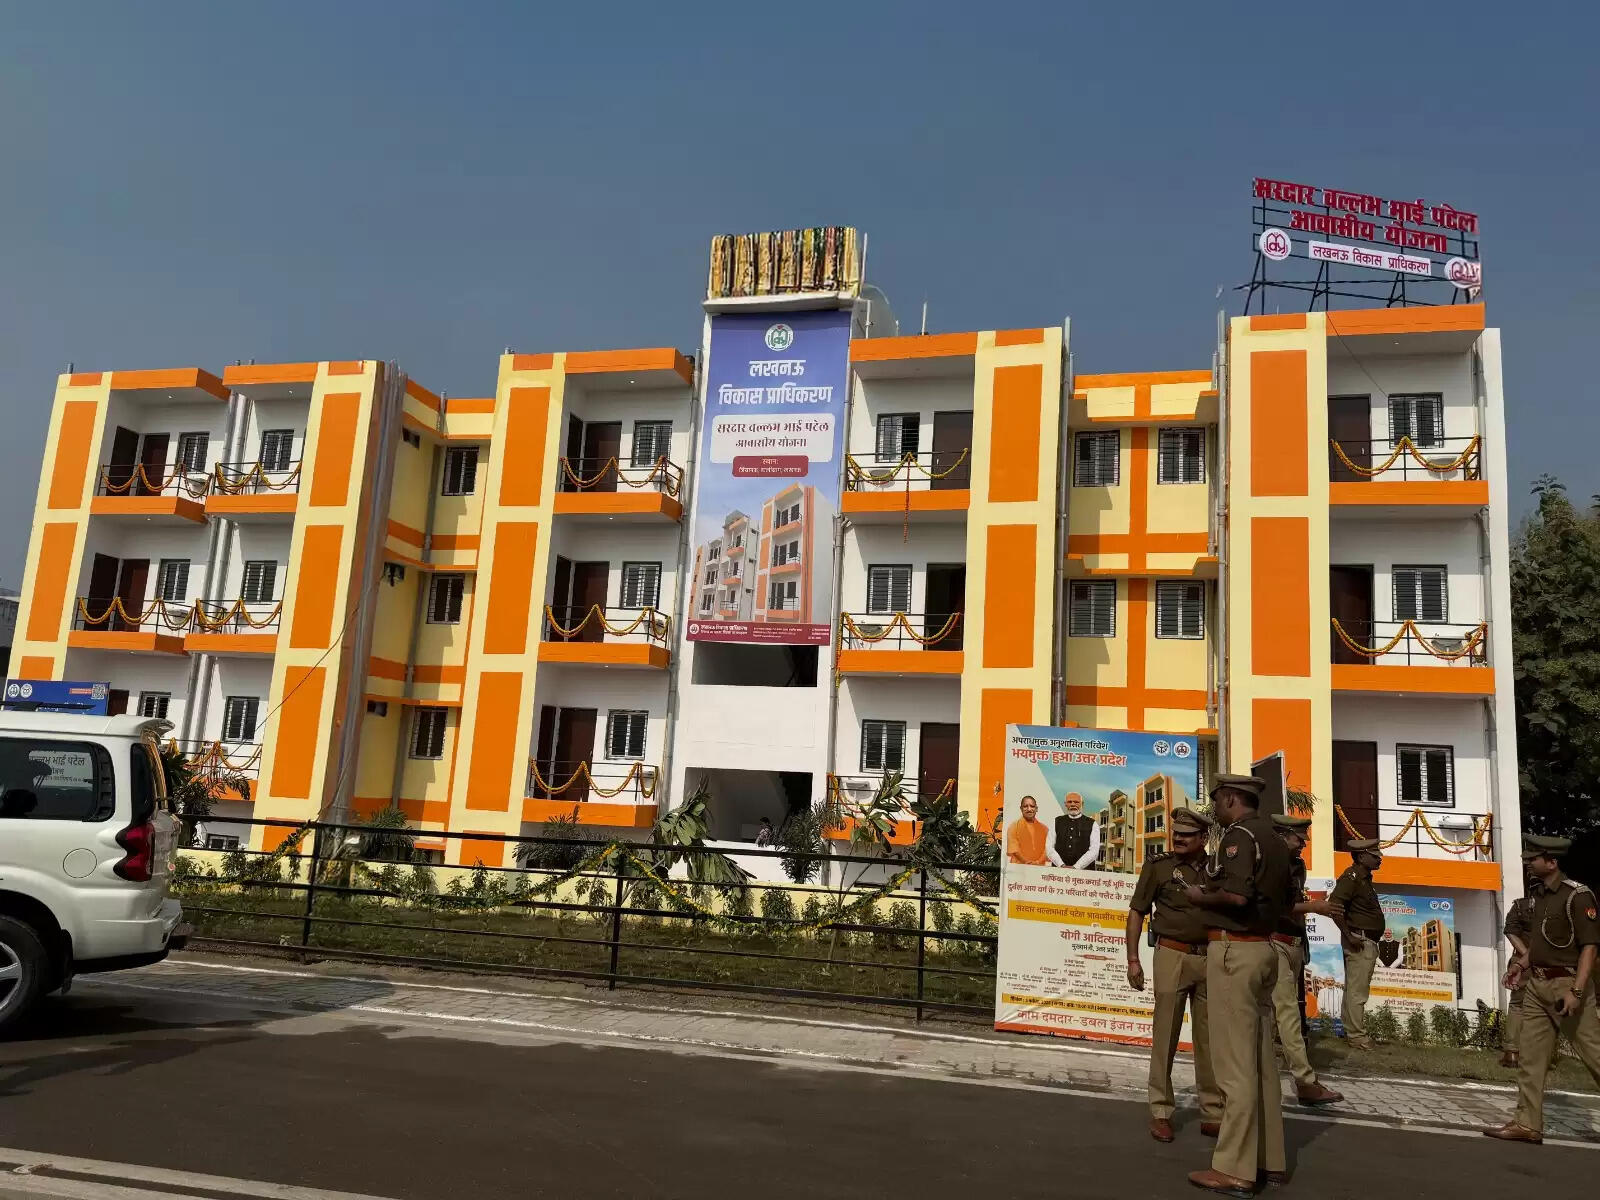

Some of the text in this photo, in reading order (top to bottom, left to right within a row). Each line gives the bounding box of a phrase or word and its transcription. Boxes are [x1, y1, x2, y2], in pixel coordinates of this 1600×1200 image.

[1254, 178, 1478, 233] सरदार वल्लभ भाई पटेल
[1289, 210, 1447, 253] आवासीय योजना
[1313, 246, 1429, 274] लखनऊ विकास प्राधिकरण
[749, 359, 806, 377] लखनऊ
[719, 382, 833, 405] विकास प्राधिकरण
[717, 423, 746, 433] सरदार
[784, 419, 802, 432] भाई
[806, 420, 829, 432] पटेल
[735, 436, 807, 447] आवासीय योजना
[1012, 736, 1108, 750] अपराधमुक्त अनुशासित परिवेश
[52, 754, 66, 765] भाई
[68, 755, 85, 766] पटेल
[1012, 748, 1126, 766] भयमुक्त हुआ उत्तर प्रदेश
[1008, 881, 1023, 892] दुर्बल
[1024, 884, 1036, 892] आय
[1037, 884, 1047, 893] वर्ग
[1048, 886, 1055, 894] के
[1065, 888, 1087, 897] परिवारों
[1088, 889, 1097, 898] को
[1099, 890, 1114, 900] फ्लैट
[1115, 891, 1123, 900] के
[1041, 874, 1064, 883] माफिया
[1064, 875, 1071, 883] से
[1071, 876, 1085, 886] मुक्त
[1085, 876, 1101, 887] कराई
[1102, 878, 1112, 888] गई
[1113, 880, 1124, 890] भूमि
[1016, 904, 1035, 912] सरदार
[1070, 909, 1085, 918] पटेल
[1087, 911, 1115, 921] आवासीय
[1060, 929, 1080, 940] योगी
[1018, 1010, 1039, 1021] काम
[1109, 1017, 1135, 1032] इंजन
